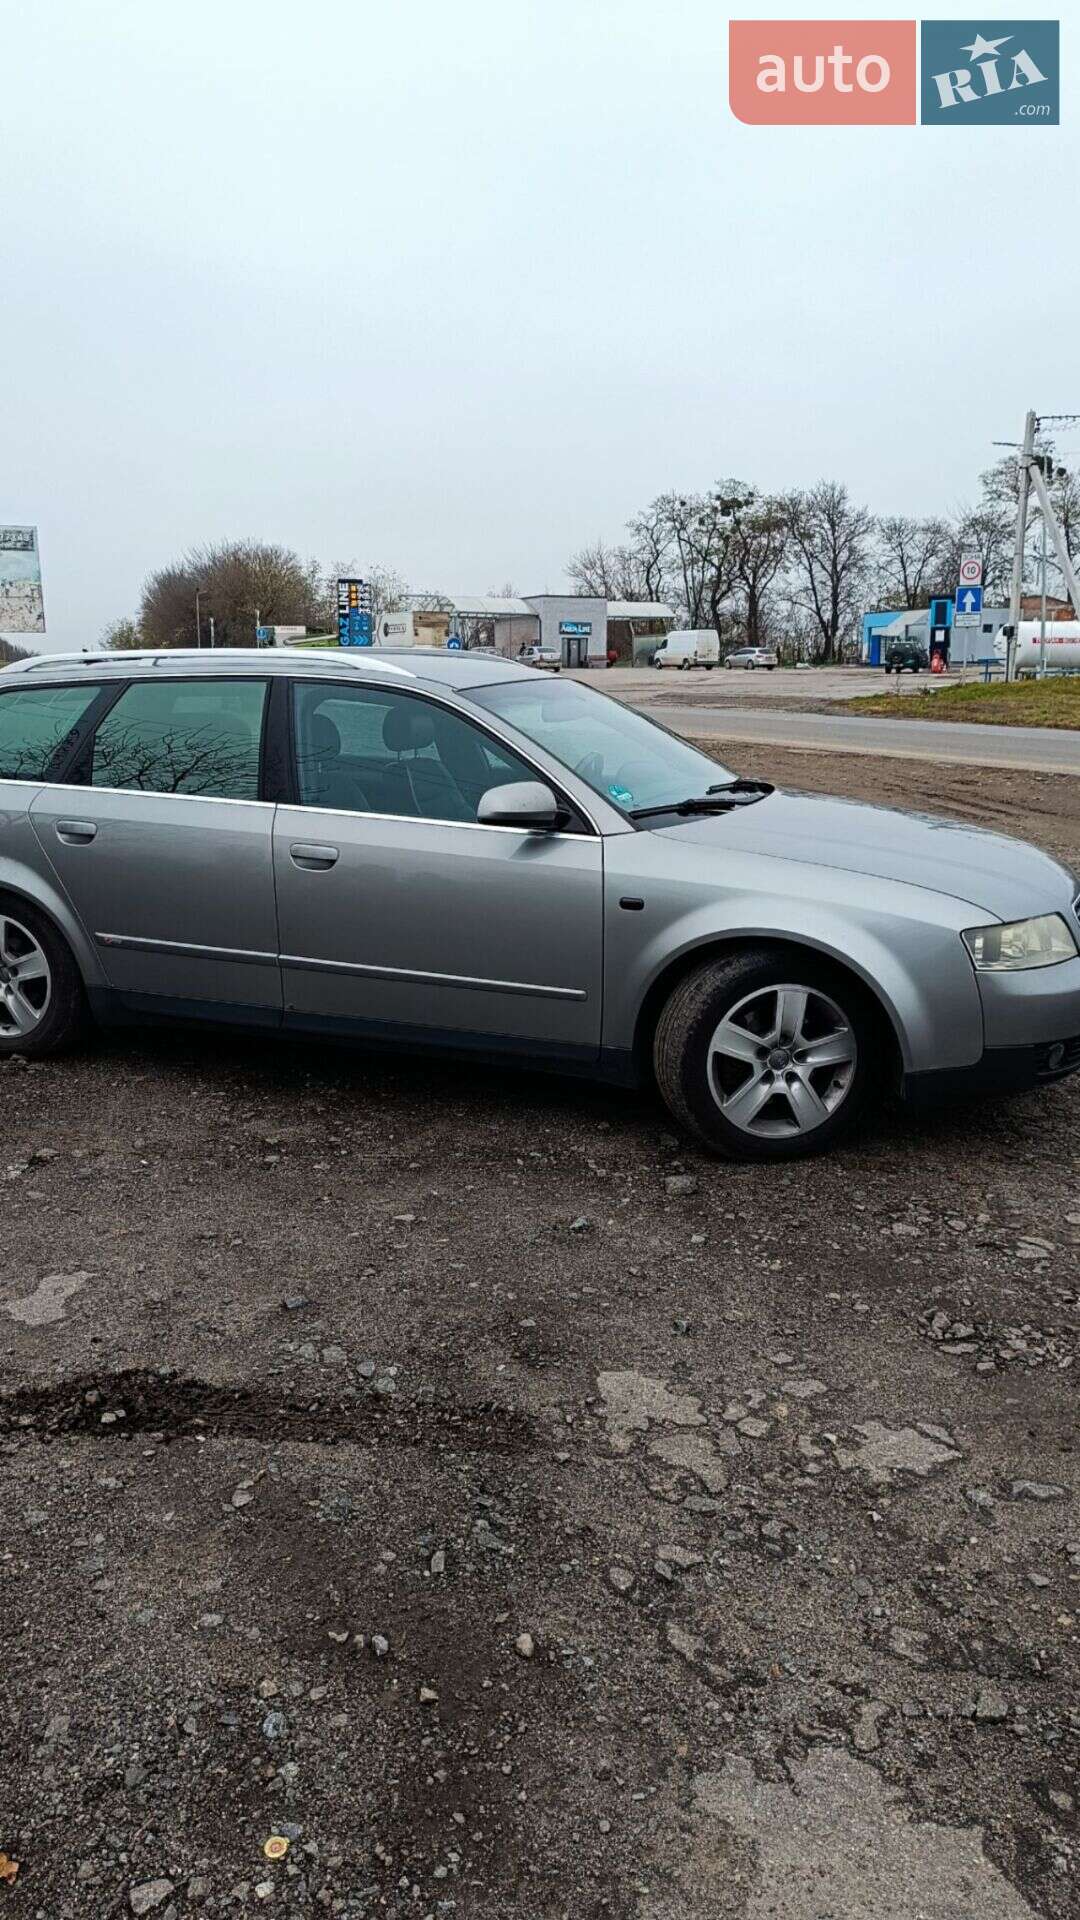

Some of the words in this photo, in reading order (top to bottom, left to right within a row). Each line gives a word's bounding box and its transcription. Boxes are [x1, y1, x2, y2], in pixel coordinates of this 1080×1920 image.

[966, 566, 977, 574] 10
[340, 582, 350, 614] LINE
[340, 617, 350, 646] GAZ
